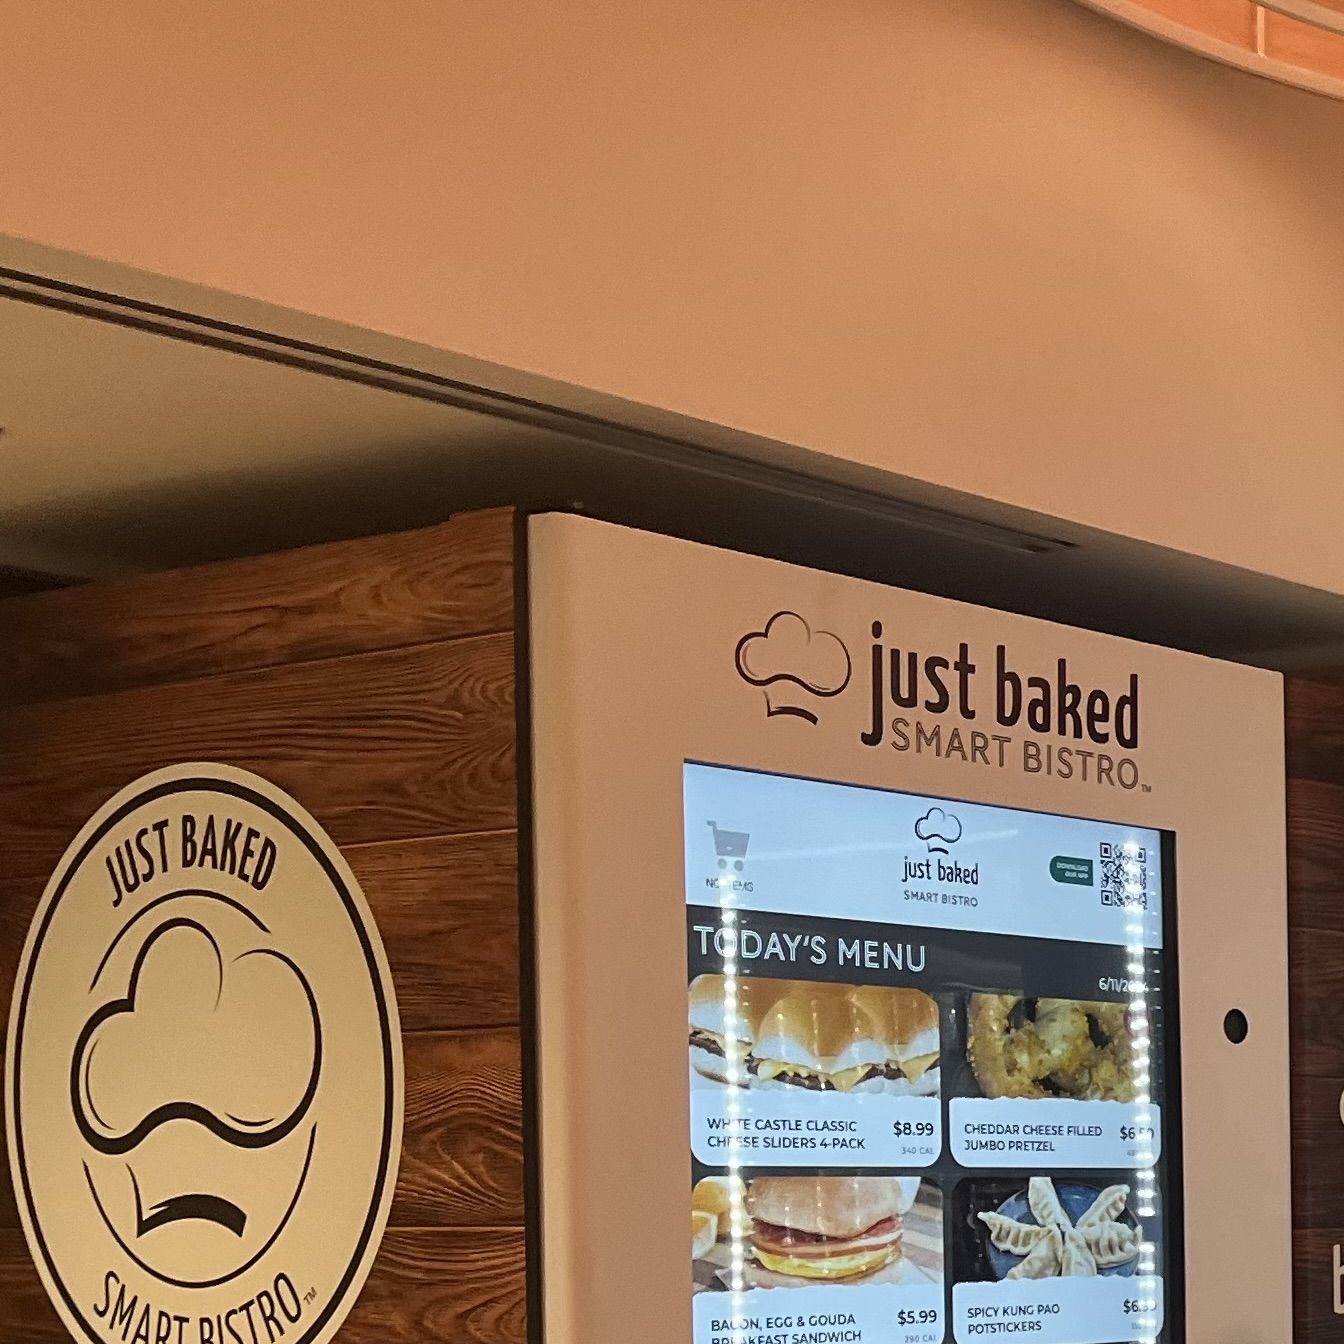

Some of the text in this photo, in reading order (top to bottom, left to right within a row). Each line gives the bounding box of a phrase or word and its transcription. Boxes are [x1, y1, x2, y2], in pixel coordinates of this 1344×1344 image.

[860, 620, 1138, 750] just baked
[891, 717, 1012, 768] SMART
[105, 814, 277, 908] JUST BAKED
[902, 856, 979, 886] just baked
[903, 889, 978, 908] SMART BISTRO
[693, 925, 926, 973] TODAY'S MENU
[754, 1117, 803, 1132] CASTLE
[806, 1120, 857, 1132] CLASSIC
[893, 1121, 934, 1137] $8.99
[964, 1123, 1103, 1137] CHEDDAR CHEESE FILLED
[763, 1136, 816, 1149] SLIDERS
[819, 1136, 865, 1150] 4-PACK
[964, 1139, 1055, 1152] JUMBO PRETZEL
[897, 1309, 938, 1327] $5.99
[967, 1303, 1060, 1319] SPICY KUNG PAO
[766, 1315, 796, 1329] EGG
[797, 1315, 805, 1328] &
[808, 1313, 857, 1327] GOUDA
[967, 1320, 1042, 1335] POTSTICKERS
